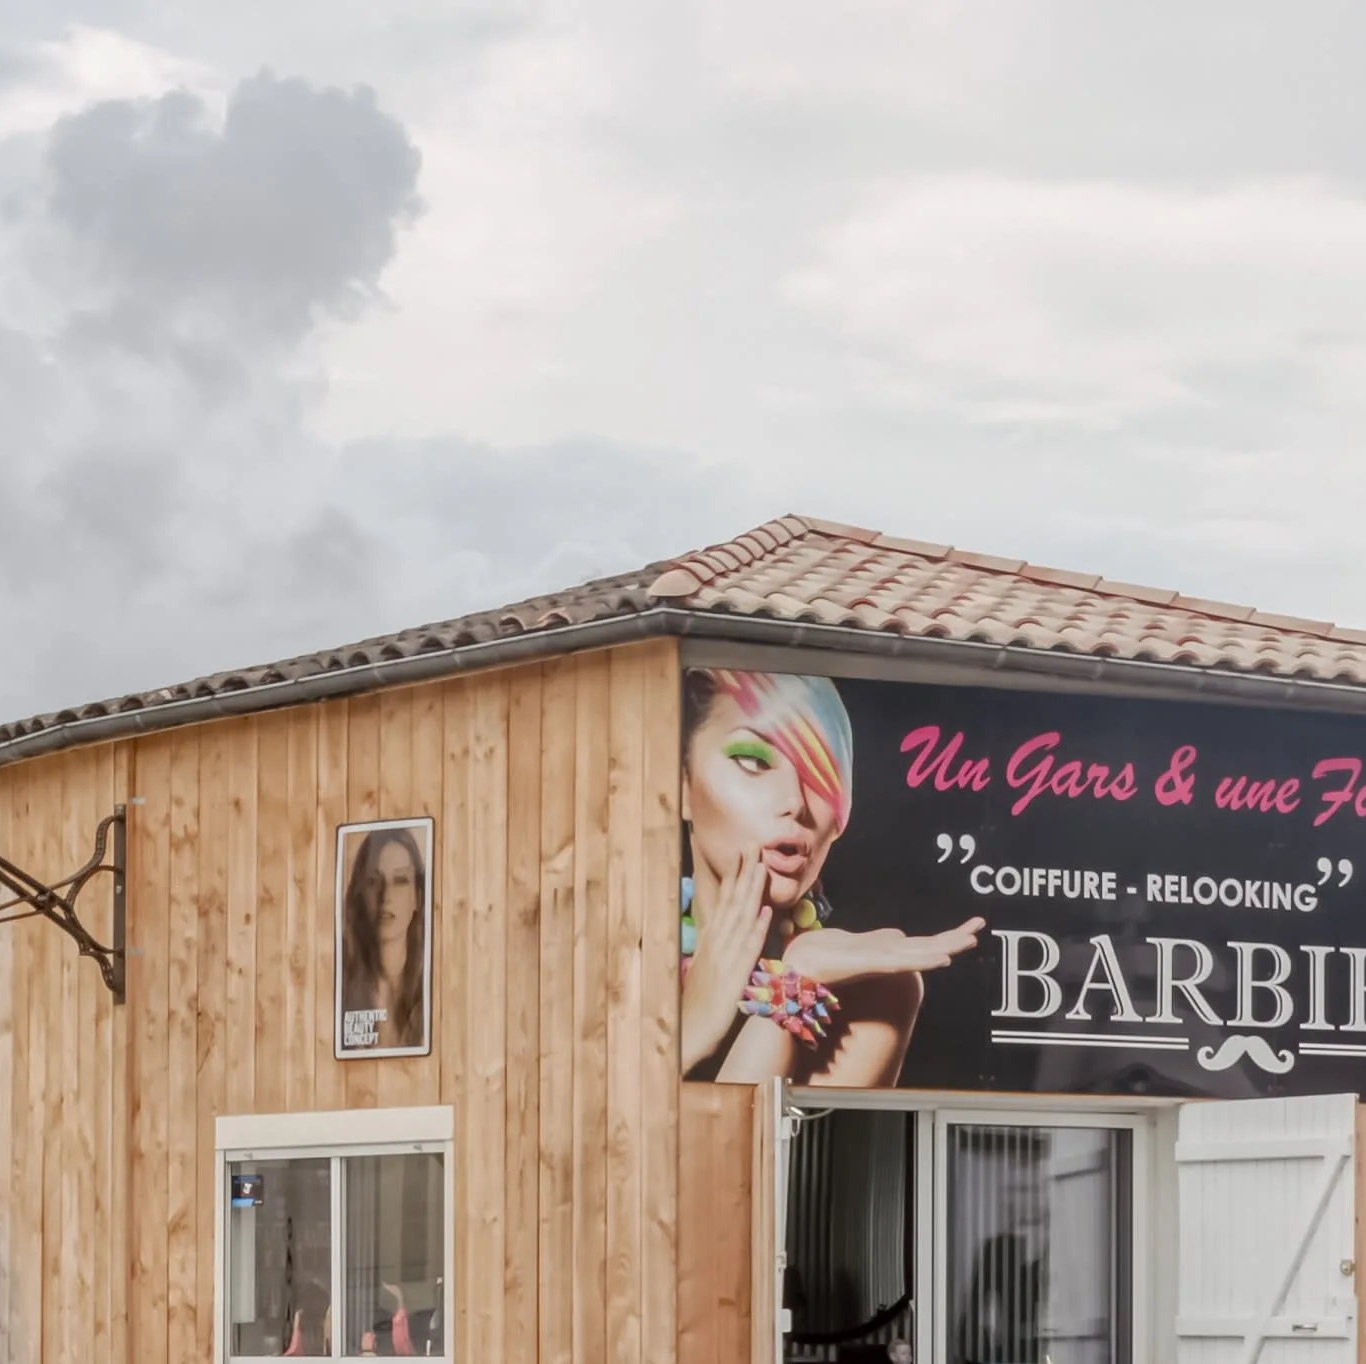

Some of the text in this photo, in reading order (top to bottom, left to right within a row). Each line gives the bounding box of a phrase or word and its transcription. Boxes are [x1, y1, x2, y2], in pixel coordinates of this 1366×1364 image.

[900, 725, 990, 791] Un
[1006, 731, 1138, 816] Gars
[1154, 745, 1197, 805] &
[1215, 774, 1300, 814] une
